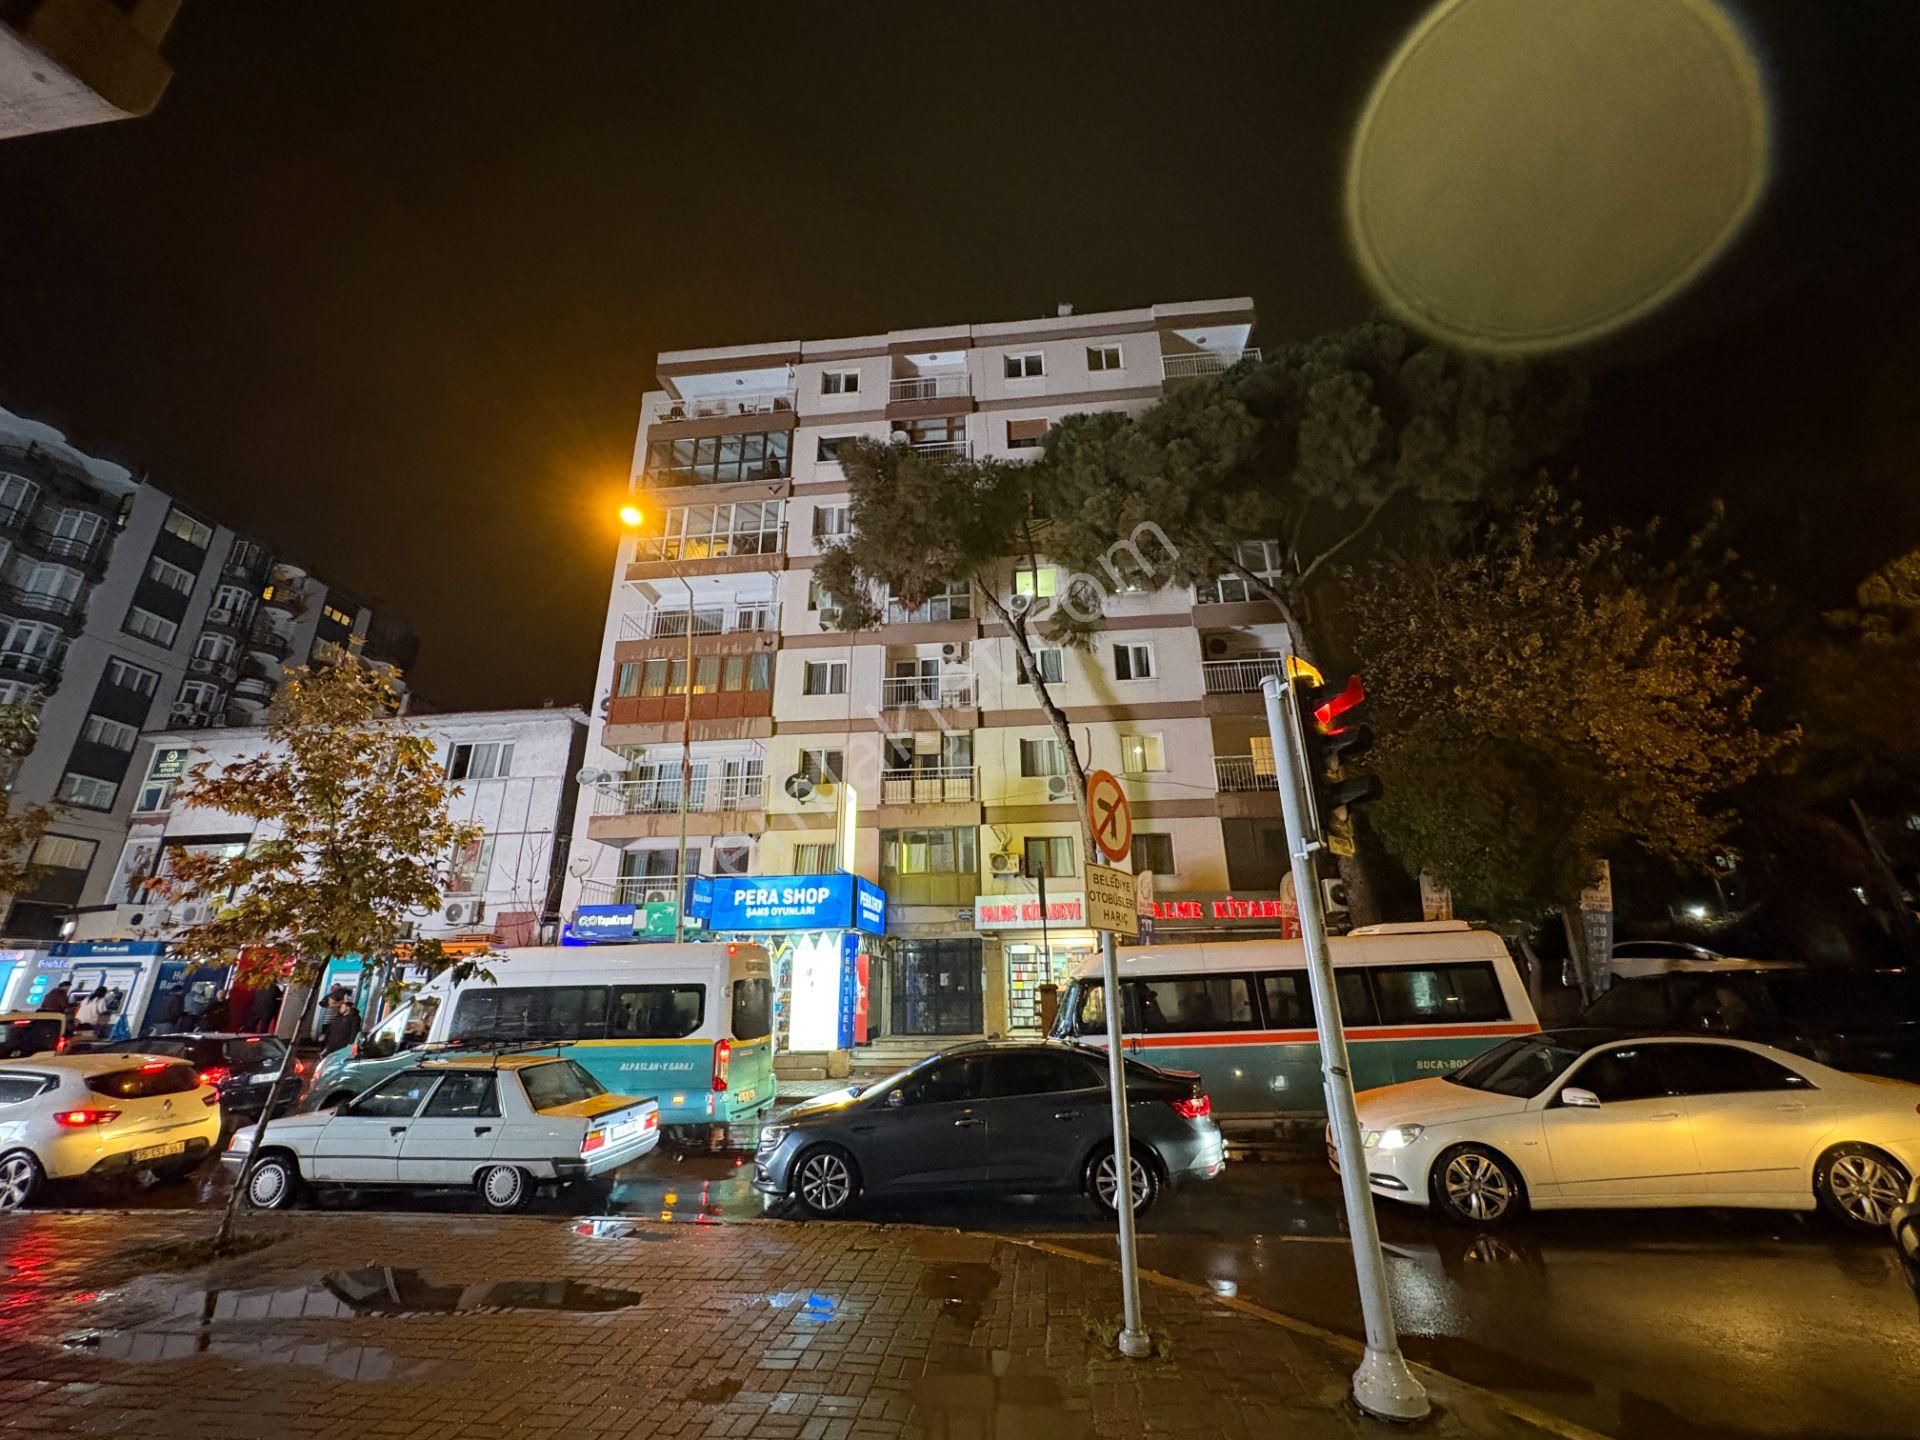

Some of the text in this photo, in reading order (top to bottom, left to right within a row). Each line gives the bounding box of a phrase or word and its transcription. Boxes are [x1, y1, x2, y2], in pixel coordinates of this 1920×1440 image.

[734, 887, 830, 906] PERA SHOP
[745, 905, 816, 918] ŞANS OYUNLARI
[1021, 897, 1082, 921] KİABEVİ
[1152, 901, 1204, 919] ALME
[842, 987, 851, 1032] TEKEL
[619, 1062, 659, 1071] ALPASLAN
[1415, 1060, 1444, 1070] BUCA
